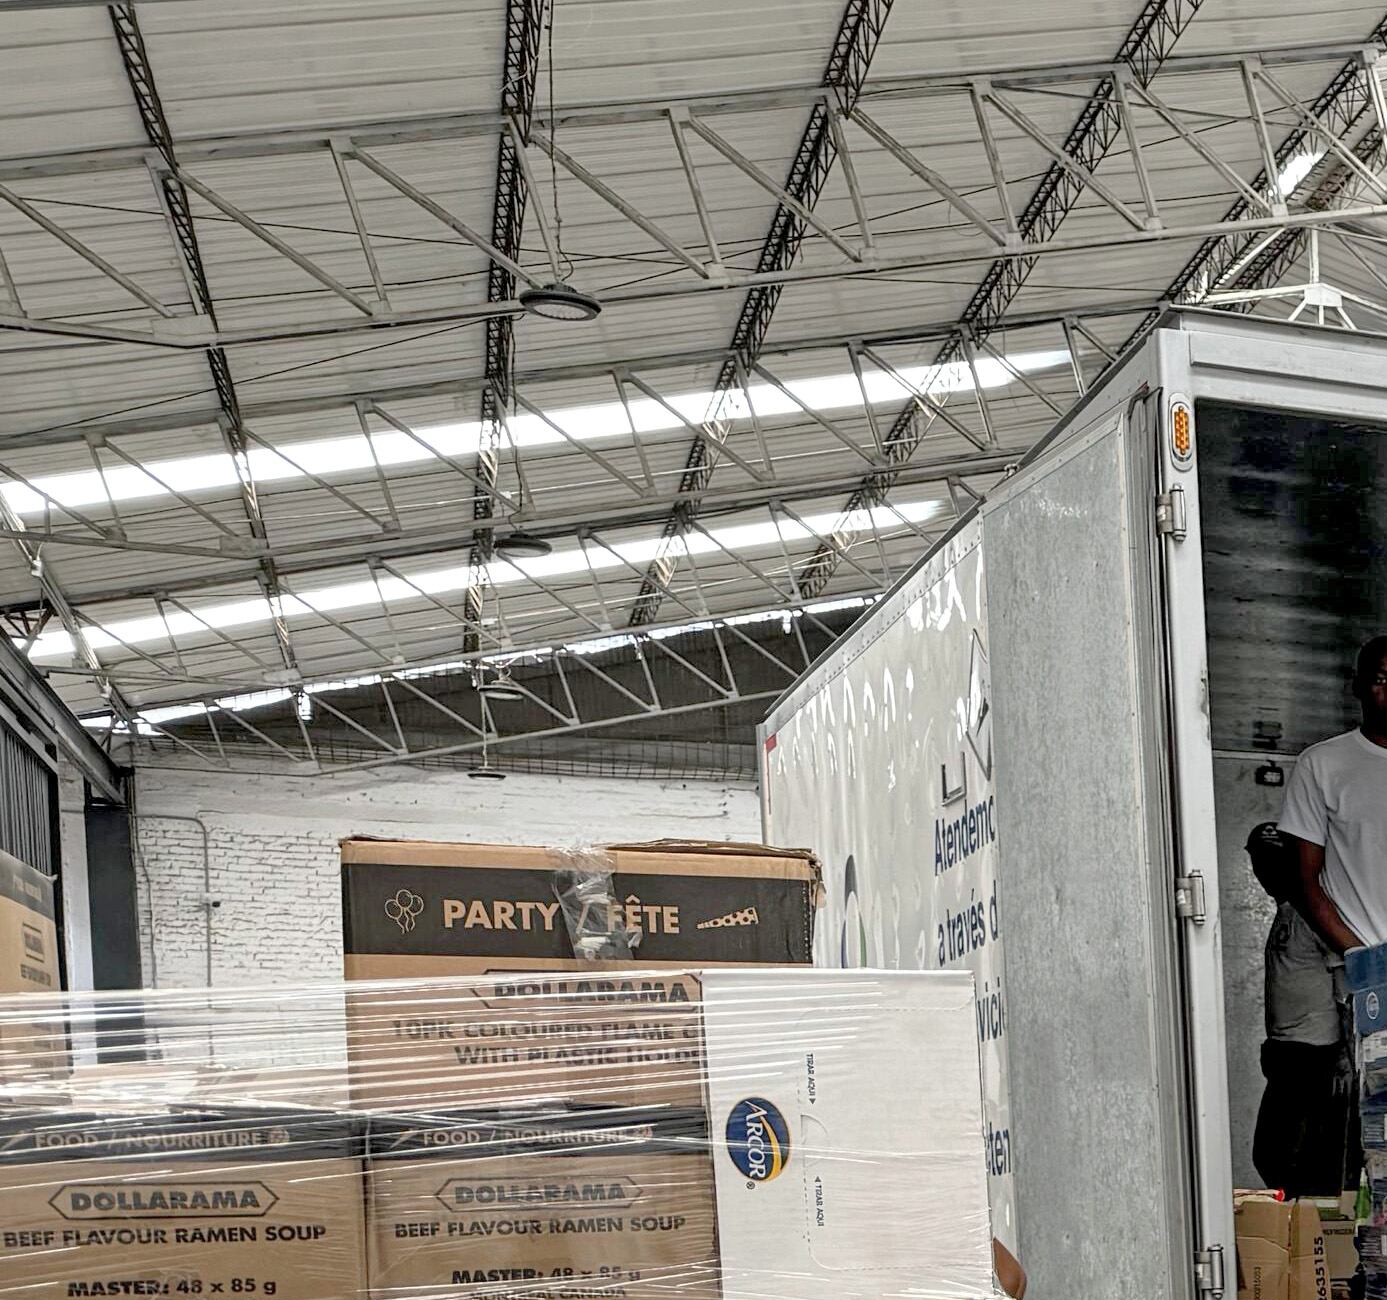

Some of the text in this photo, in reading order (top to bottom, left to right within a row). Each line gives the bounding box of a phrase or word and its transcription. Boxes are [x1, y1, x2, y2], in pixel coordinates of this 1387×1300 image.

[442, 899, 561, 933] PARTY
[606, 897, 680, 934] FÊTE
[947, 888, 986, 962] través
[35, 1130, 98, 1149] FOOD
[123, 1130, 263, 1148] NOURRITURE
[423, 1130, 480, 1147] FOOD
[744, 1100, 768, 1179] ARCOR
[70, 1189, 261, 1212] DOLLARAMA
[455, 1183, 626, 1205] DOLLARAMA
[3, 1225, 327, 1248] BEEF FLAVOUR RAMEN SOUP
[395, 1215, 687, 1238] BEEF FLAVOUR RAMEN SOUP
[67, 1278, 278, 1297] MASTER: 48 x 85 g
